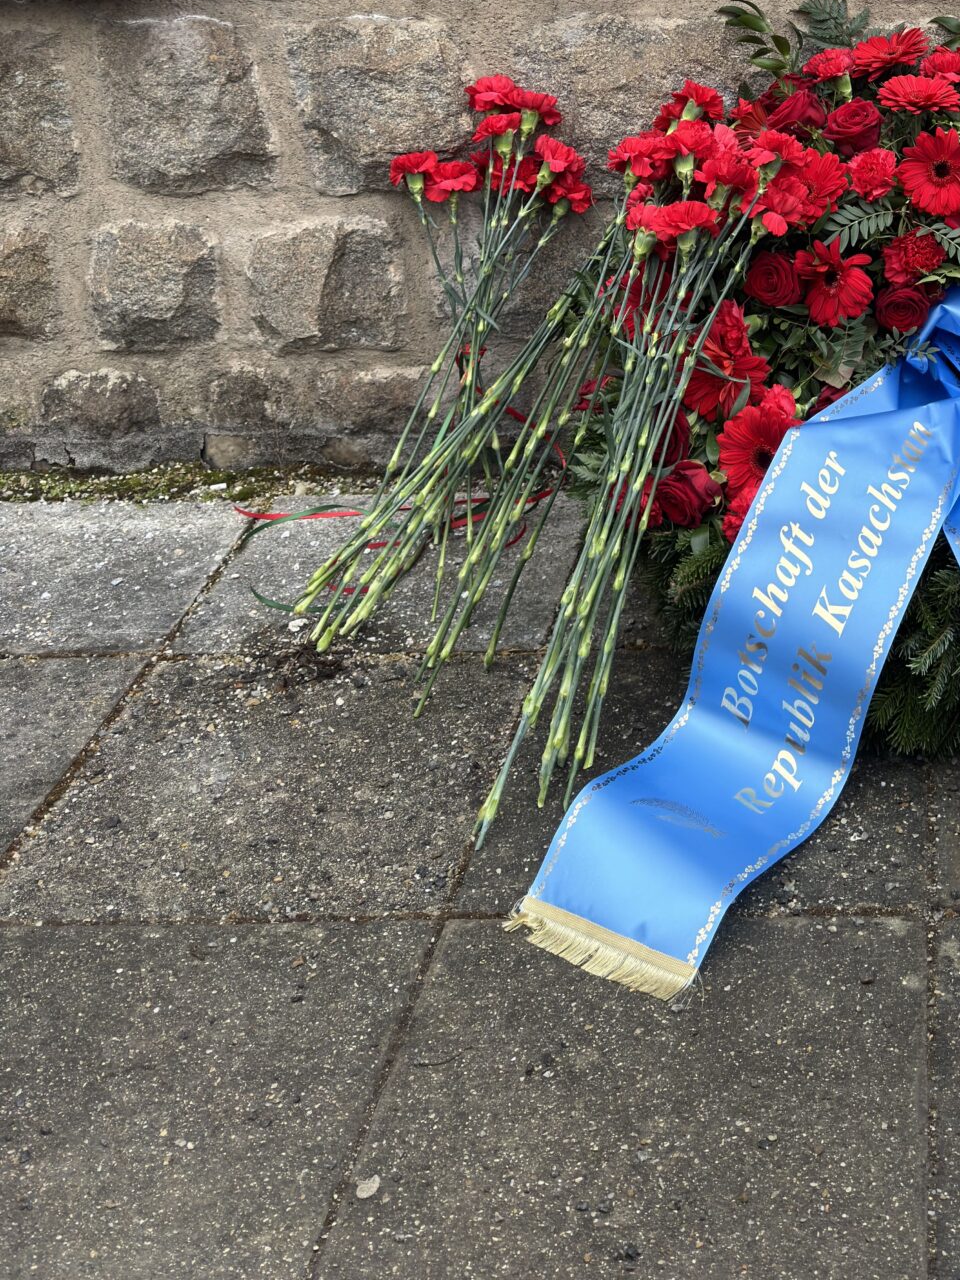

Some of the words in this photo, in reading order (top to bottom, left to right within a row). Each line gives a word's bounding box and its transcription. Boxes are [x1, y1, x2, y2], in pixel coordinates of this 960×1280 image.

[721, 520, 815, 734] Botschaft
[800, 450, 848, 522] der
[732, 639, 833, 816] Republik
[812, 420, 935, 639] Kasachstan
